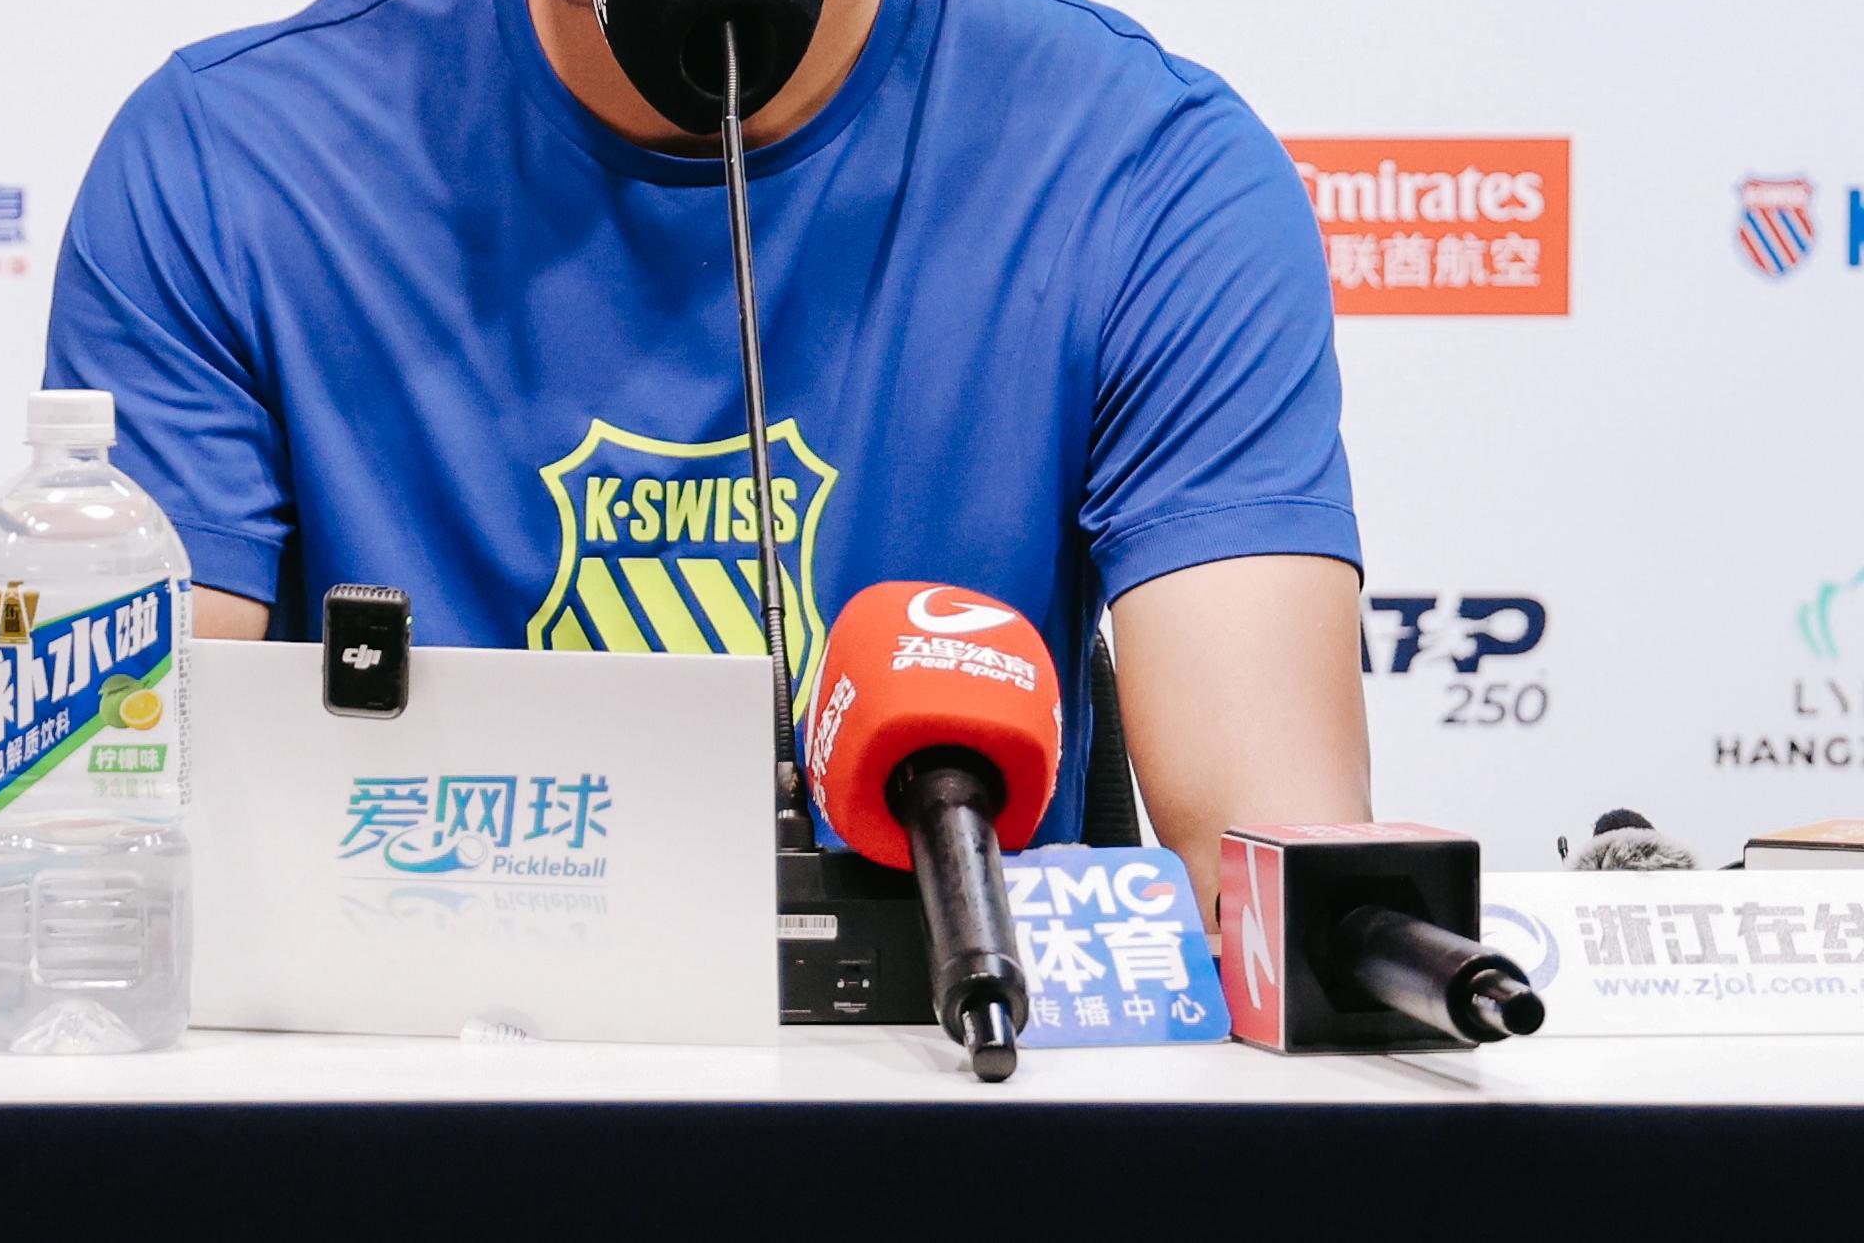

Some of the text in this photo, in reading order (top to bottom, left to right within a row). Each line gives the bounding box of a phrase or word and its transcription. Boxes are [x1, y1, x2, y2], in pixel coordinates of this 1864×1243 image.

[1296, 160, 1546, 224] mirates
[892, 635, 1035, 680] 五星体育
[892, 655, 1035, 691] great sports
[1442, 684, 1548, 726] 250
[1716, 738, 1864, 766] HANG
[336, 773, 612, 874] 爱网球
[492, 854, 607, 878] Pickleball
[1016, 915, 1191, 994] 体育
[1029, 991, 1208, 1028] 传播中心
